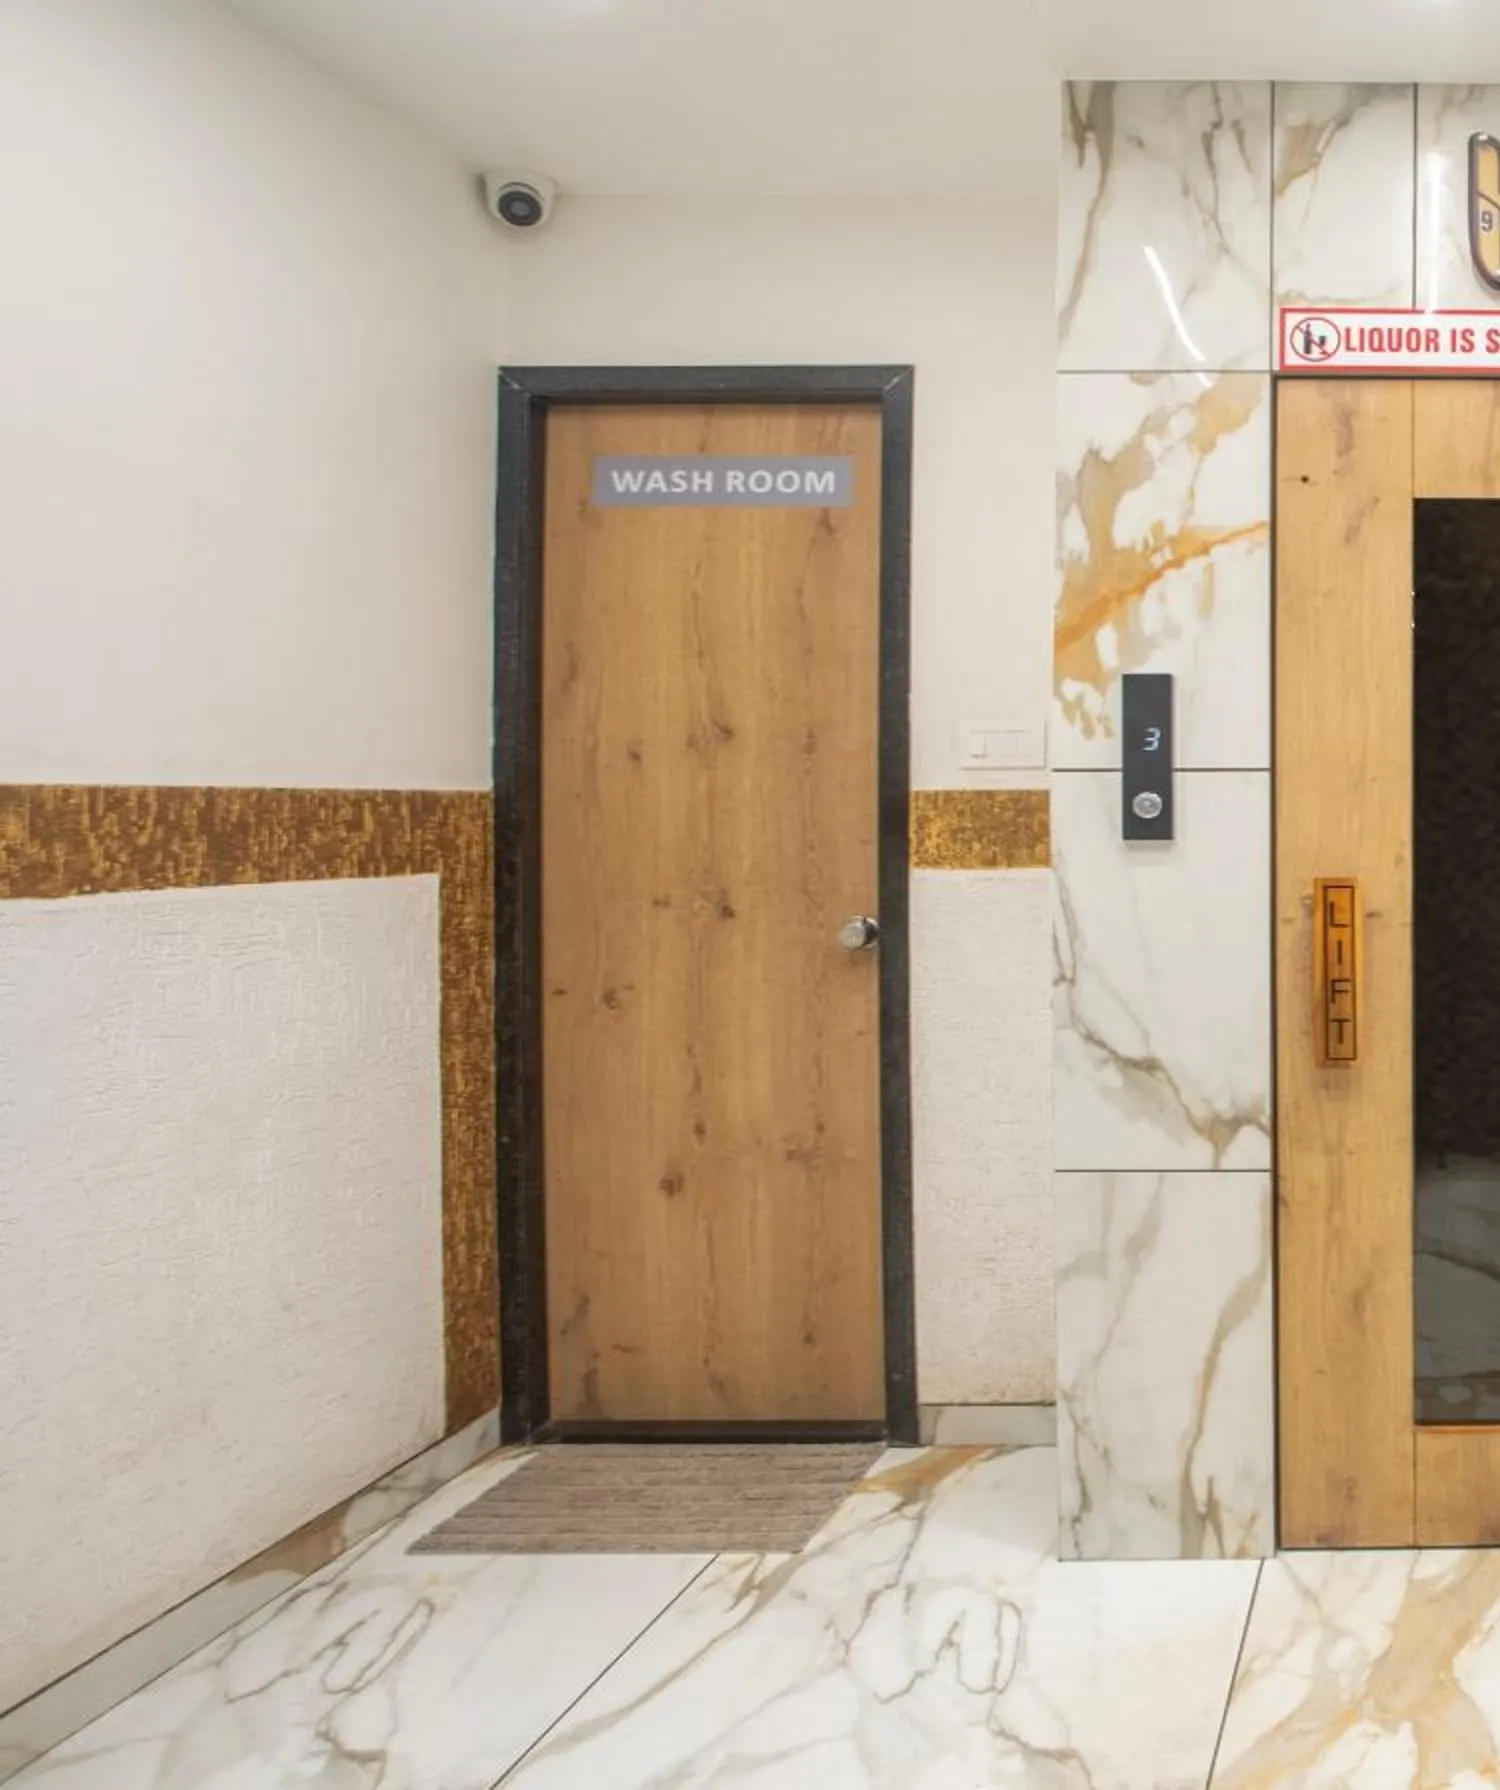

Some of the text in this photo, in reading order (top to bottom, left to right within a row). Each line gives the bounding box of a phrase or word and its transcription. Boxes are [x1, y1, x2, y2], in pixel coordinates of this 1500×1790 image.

[1480, 211, 1494, 233] 9
[1344, 327, 1440, 353] LIQUOR
[1451, 328, 1475, 354] IS
[611, 470, 836, 494] WASH ROOM
[1142, 727, 1161, 751] 3
[1330, 901, 1352, 1045] LIFT
